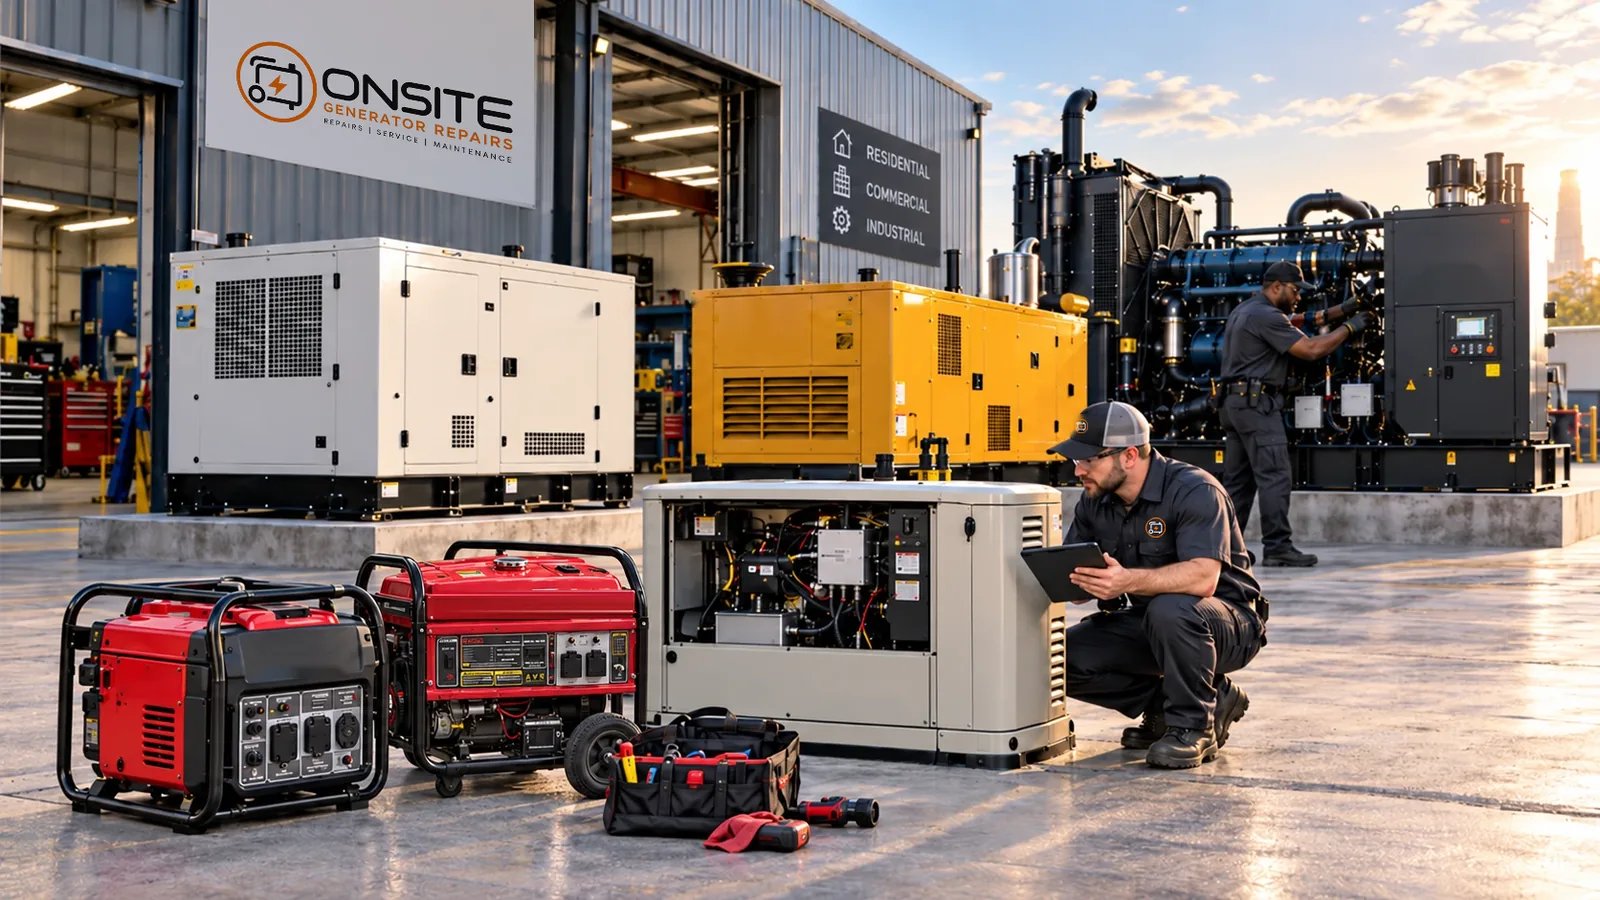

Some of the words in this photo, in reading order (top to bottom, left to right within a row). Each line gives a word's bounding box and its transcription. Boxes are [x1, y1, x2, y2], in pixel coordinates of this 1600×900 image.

[322, 67, 514, 134] ONSITE
[323, 101, 426, 133] GENERATOR
[434, 123, 514, 151] REPAIRS
[323, 117, 363, 132] REPAIRS
[376, 128, 419, 144] SERVICE
[433, 140, 513, 164] MAINTENANCE
[866, 144, 931, 180] RESIDENTIAL
[866, 182, 931, 215] COMMERCIAL
[866, 218, 926, 247] INDUSTRIAL
